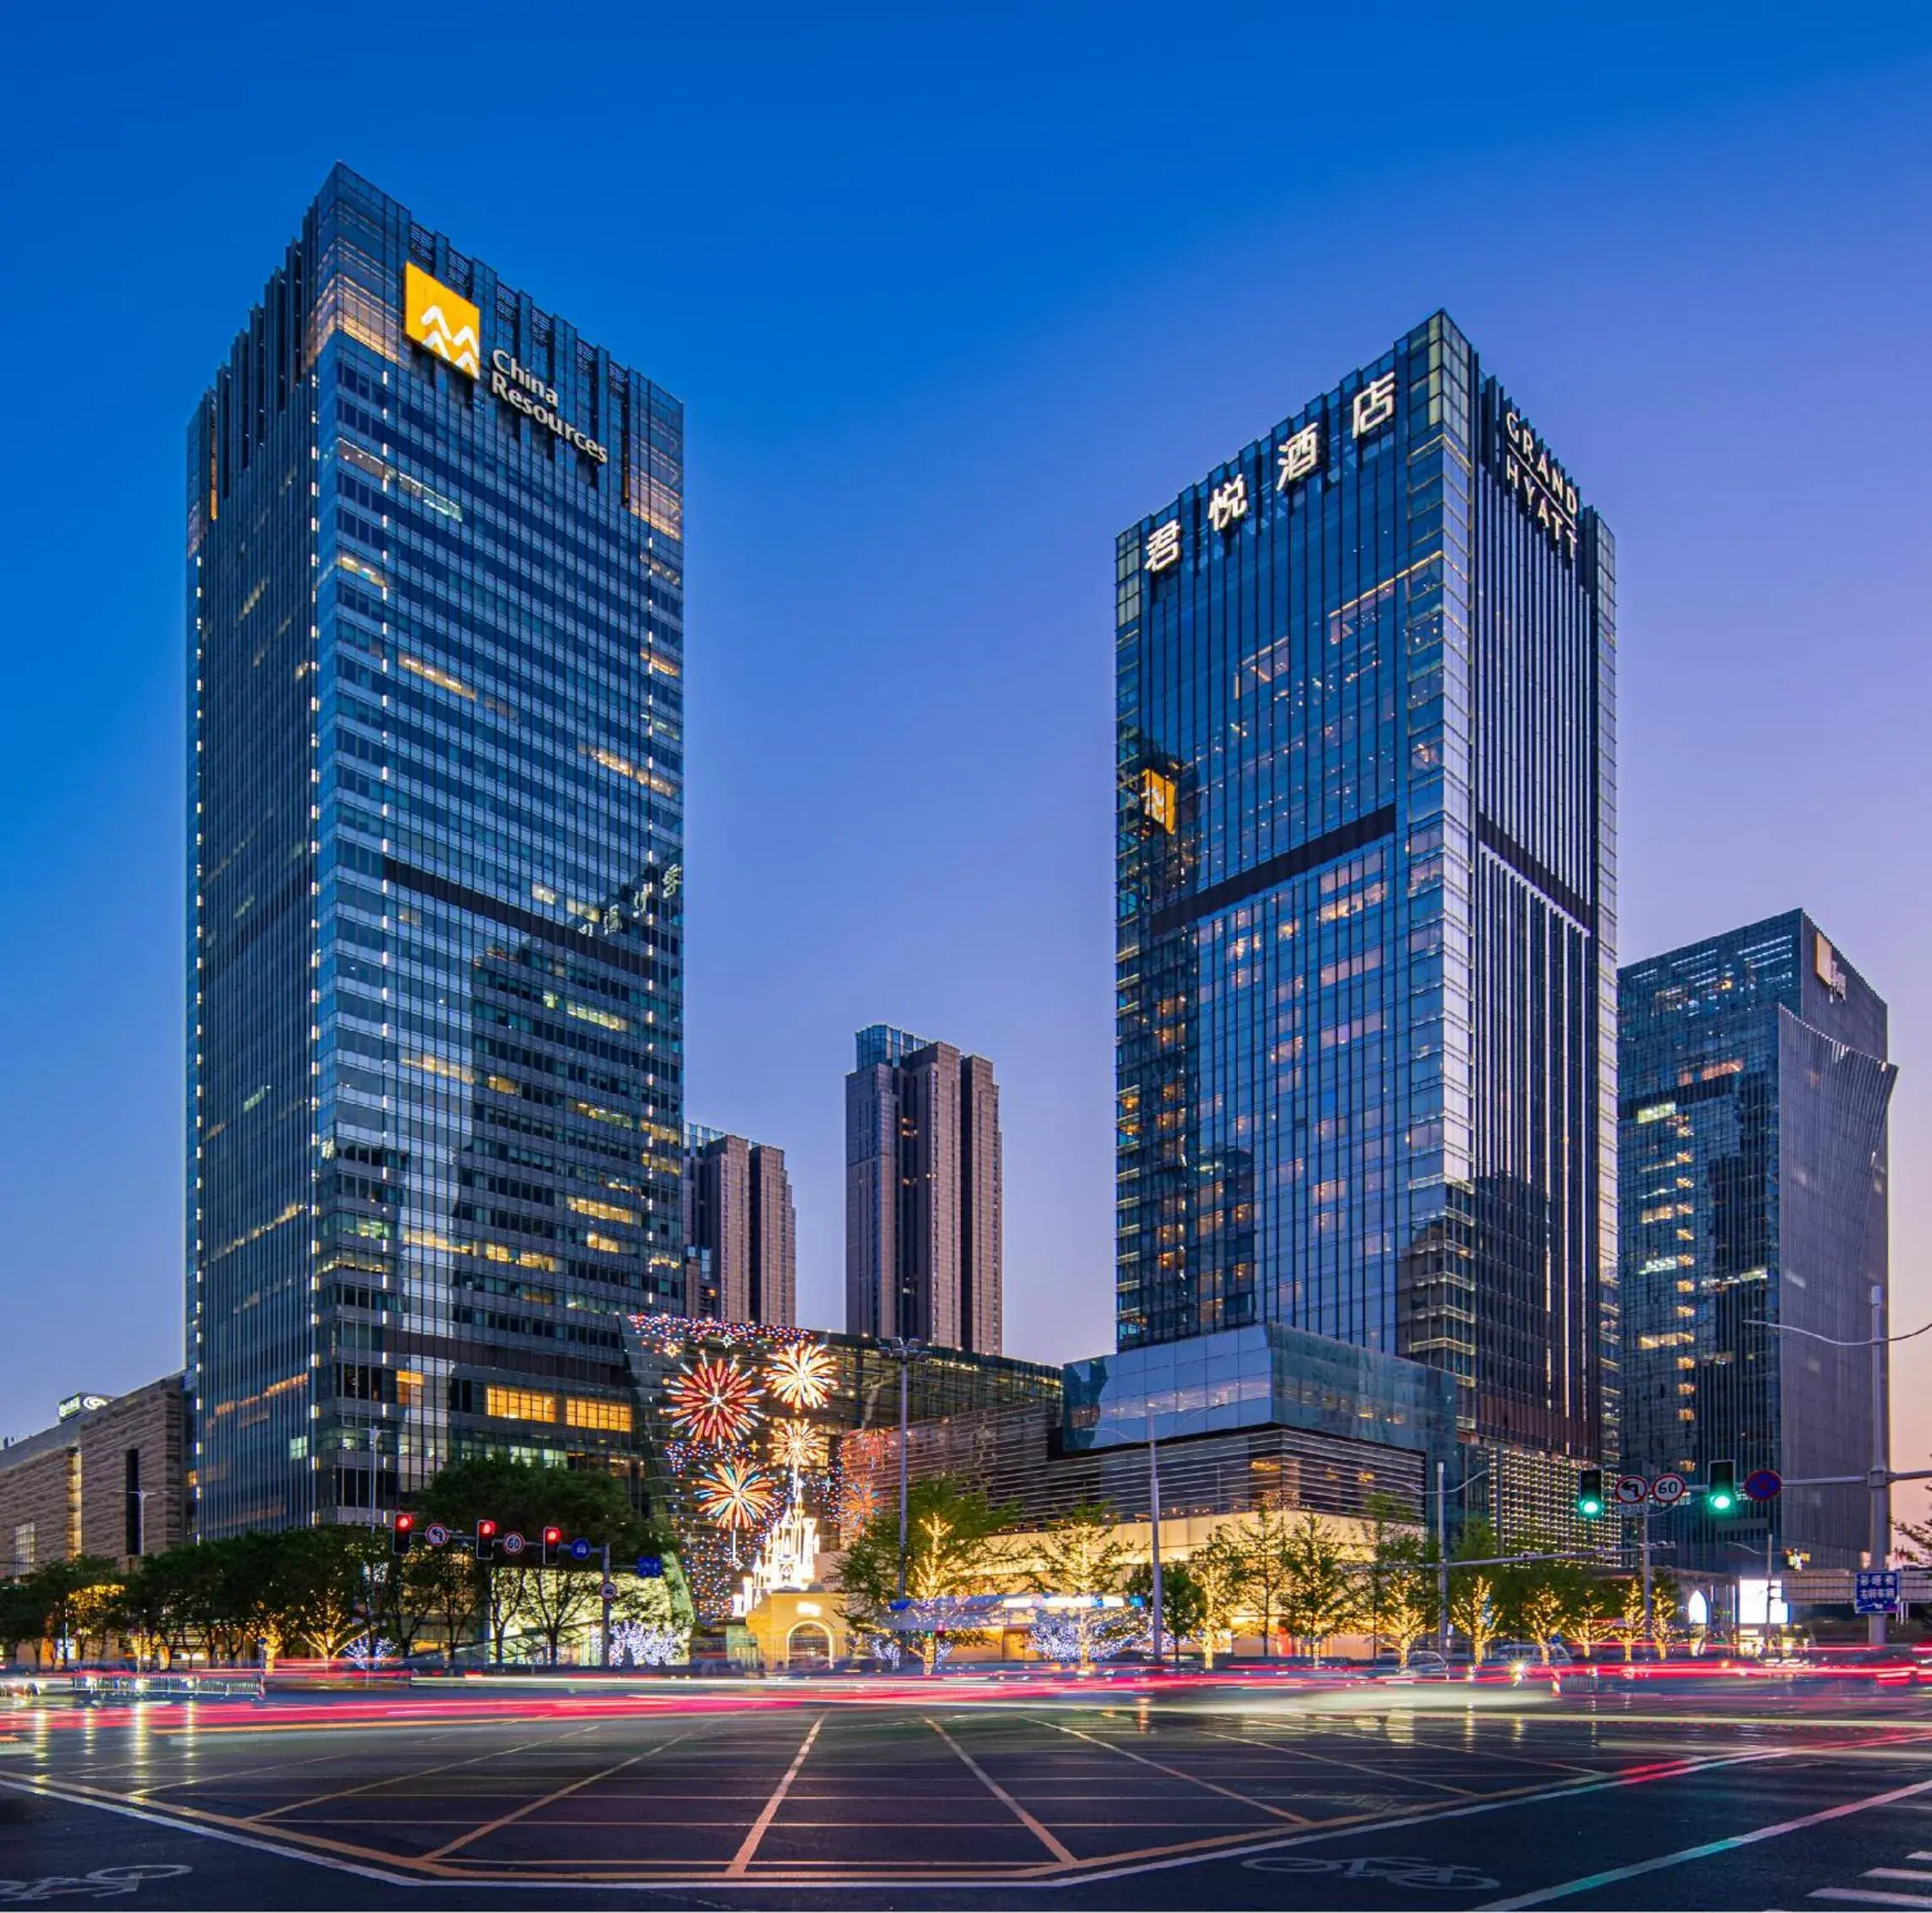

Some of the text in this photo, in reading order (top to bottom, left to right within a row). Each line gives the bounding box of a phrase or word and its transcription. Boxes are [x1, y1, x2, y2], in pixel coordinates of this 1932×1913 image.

[491, 370, 609, 464] Resources
[492, 349, 559, 407] China
[1144, 372, 1396, 573] 君悦酒店
[1506, 411, 1577, 515] GRAND
[1506, 454, 1577, 558] HYATT
[1658, 1481, 1678, 1494] 60
